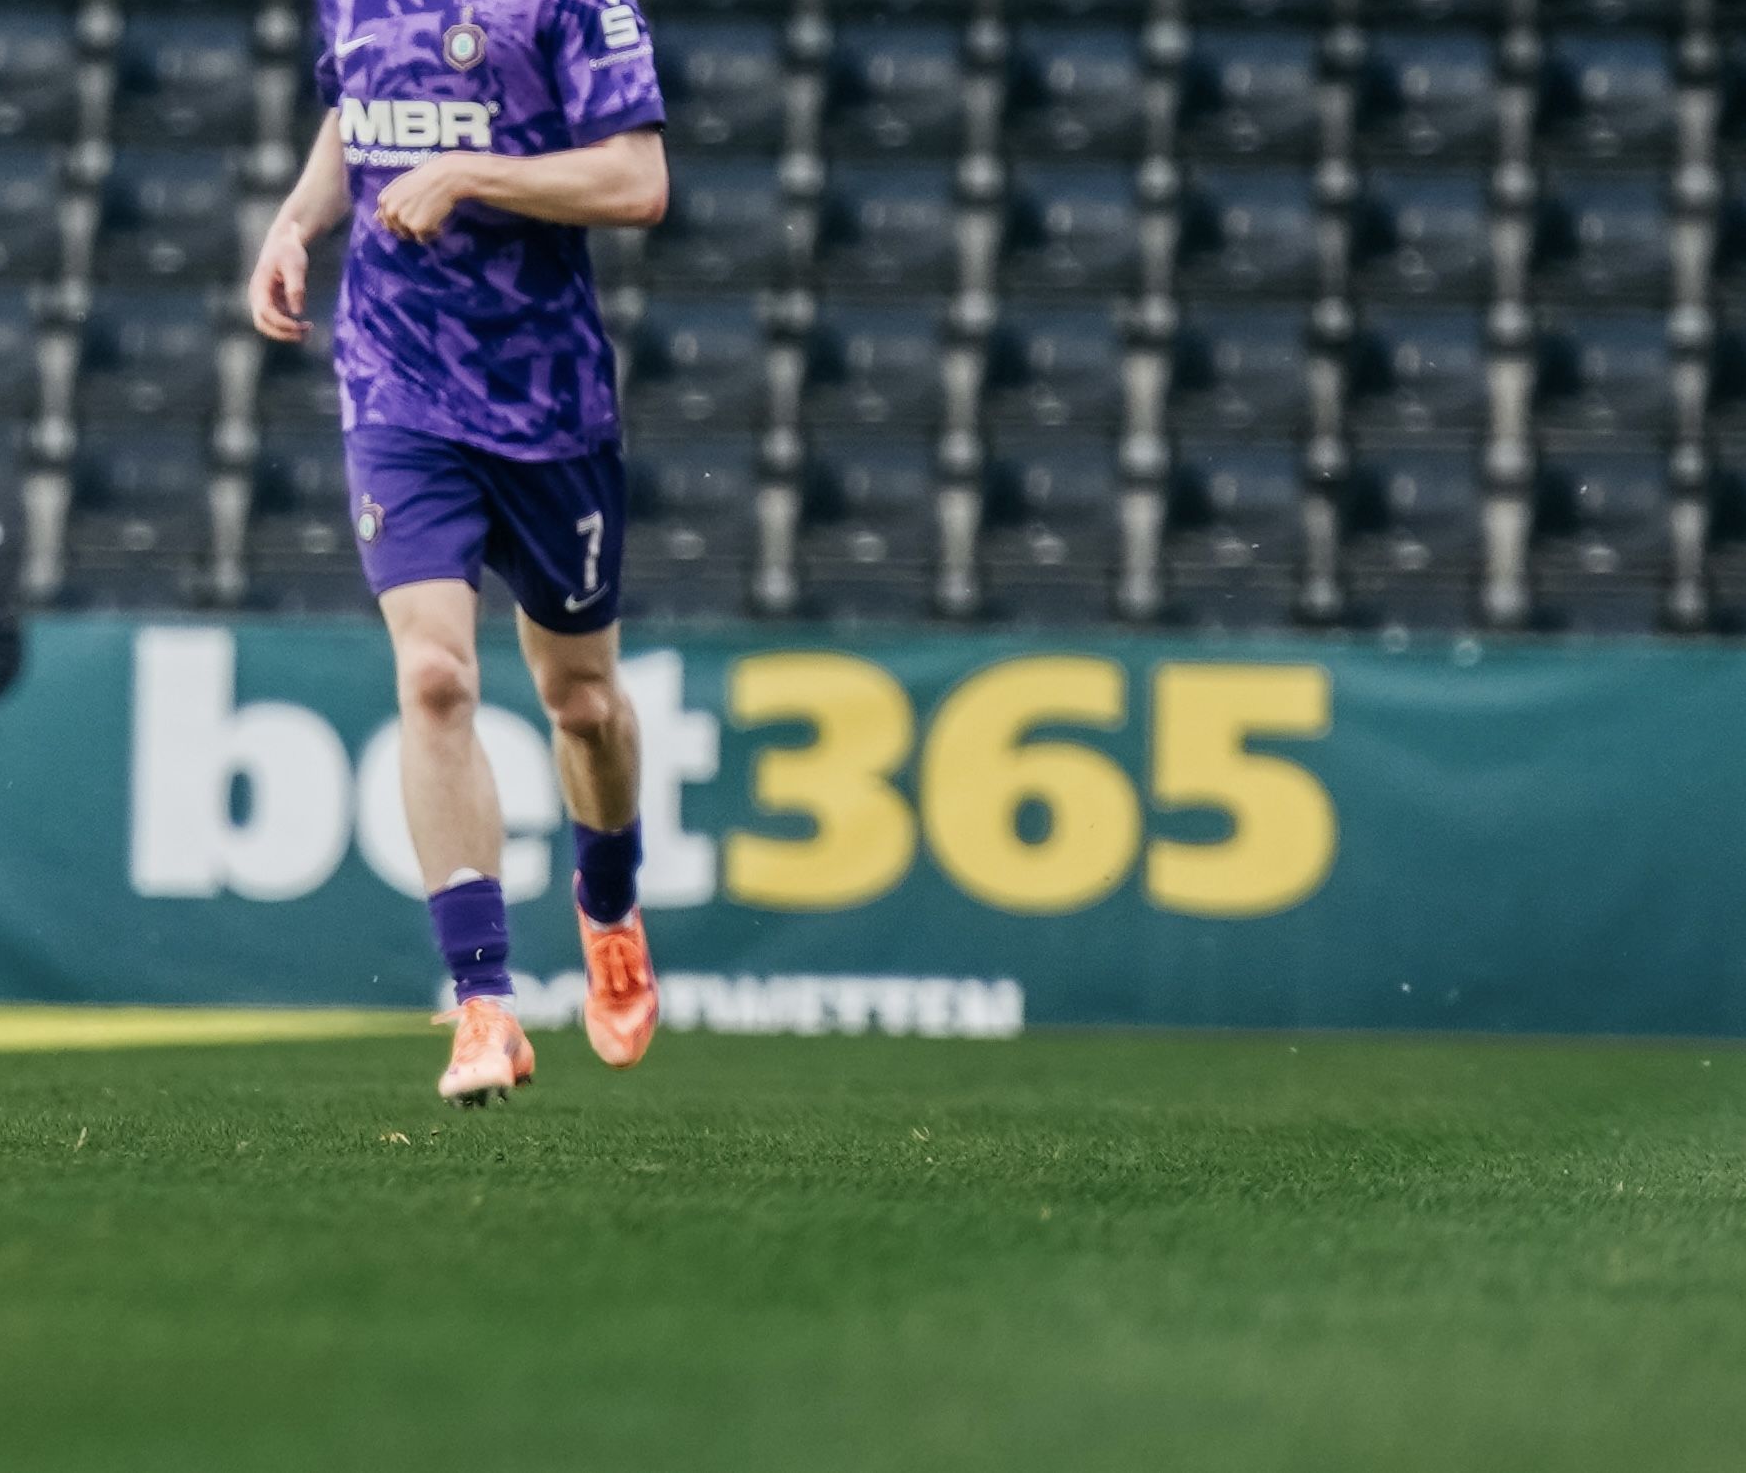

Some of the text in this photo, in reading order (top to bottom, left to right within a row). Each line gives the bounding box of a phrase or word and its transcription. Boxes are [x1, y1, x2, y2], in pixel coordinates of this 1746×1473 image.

[339, 97, 492, 148] MBR
[576, 510, 605, 591] 7
[129, 625, 1339, 917] bet365
